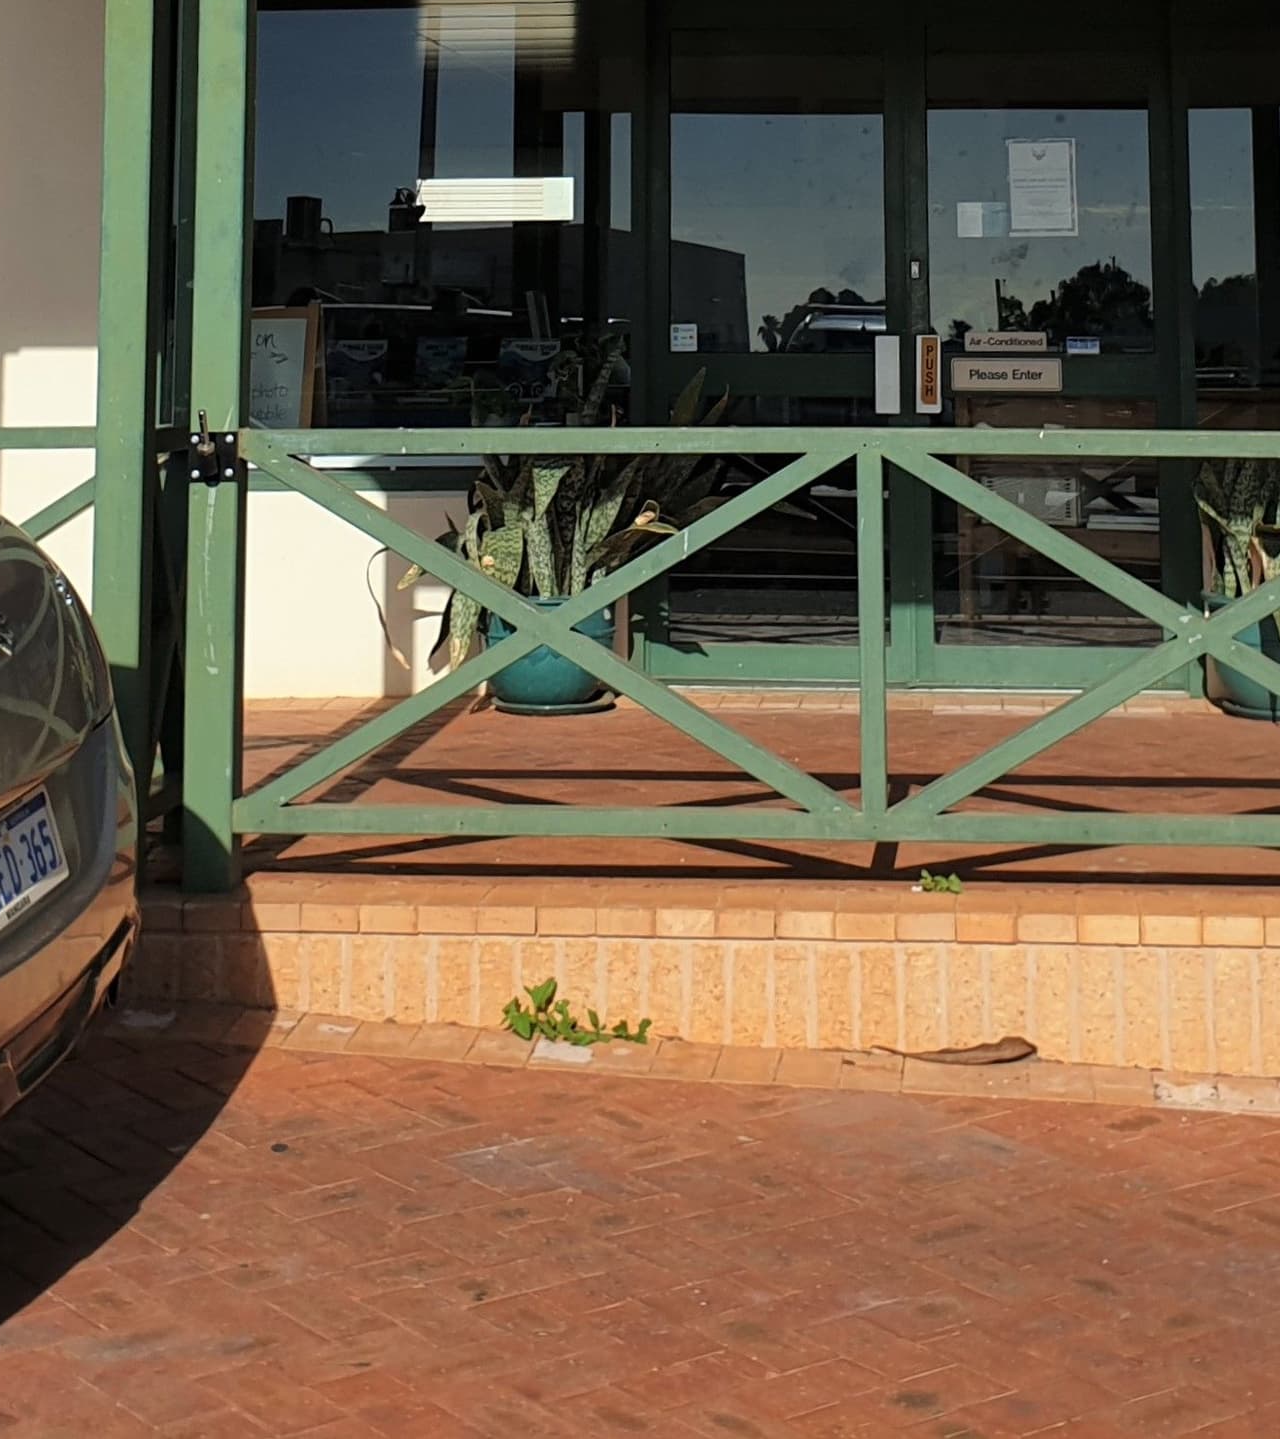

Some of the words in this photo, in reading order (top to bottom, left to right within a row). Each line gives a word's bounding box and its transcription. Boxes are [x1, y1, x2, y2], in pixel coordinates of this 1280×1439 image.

[925, 344, 934, 396] PUSH
[968, 368, 1008, 380] Please
[1012, 368, 1044, 380] Enter
